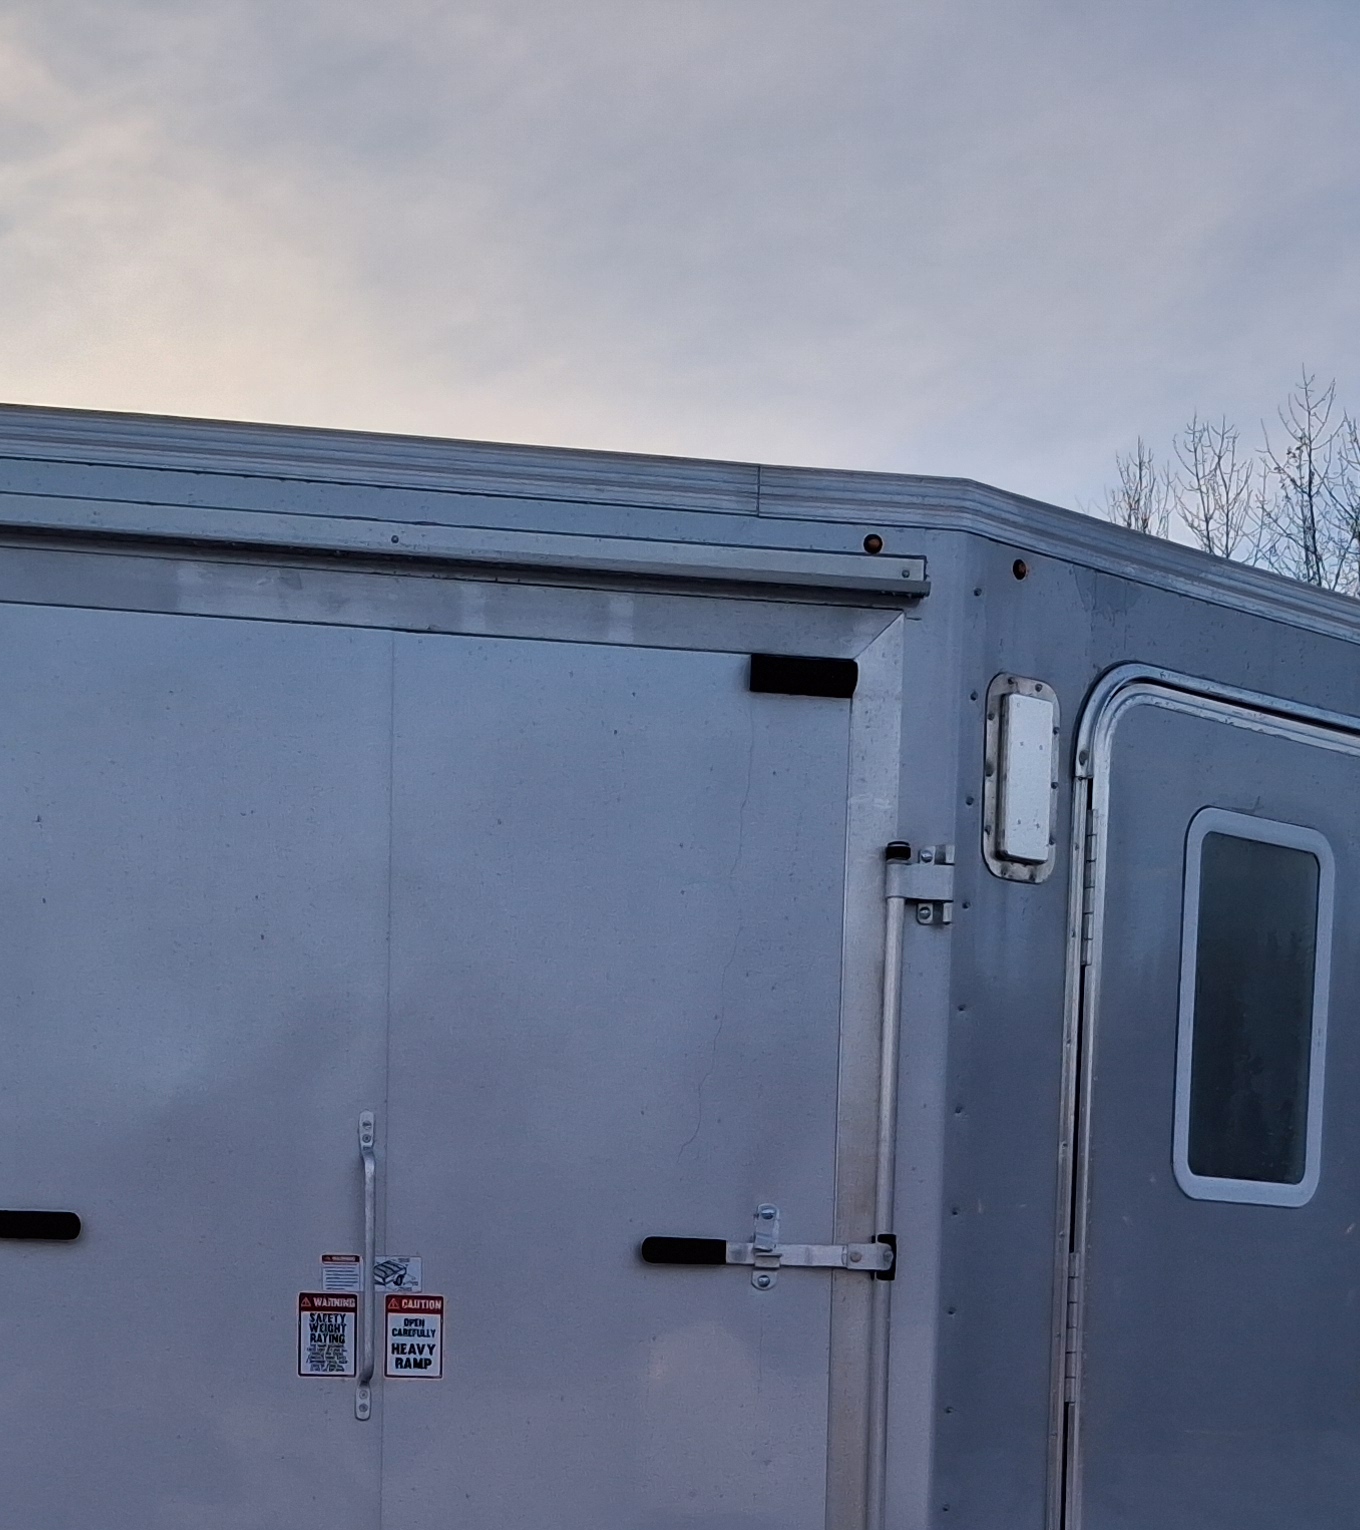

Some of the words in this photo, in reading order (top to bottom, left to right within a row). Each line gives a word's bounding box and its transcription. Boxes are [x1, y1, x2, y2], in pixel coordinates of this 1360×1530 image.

[313, 1297, 356, 1308] WARNING
[401, 1299, 442, 1309] CAUTION
[309, 1313, 346, 1323] SAFETY
[404, 1318, 425, 1327] OPEN
[309, 1323, 347, 1334] WEIGHT
[392, 1327, 436, 1338] CAREFULLY
[310, 1334, 346, 1344] RATING
[391, 1343, 436, 1356] HEAVY
[395, 1357, 432, 1370] RAMP
